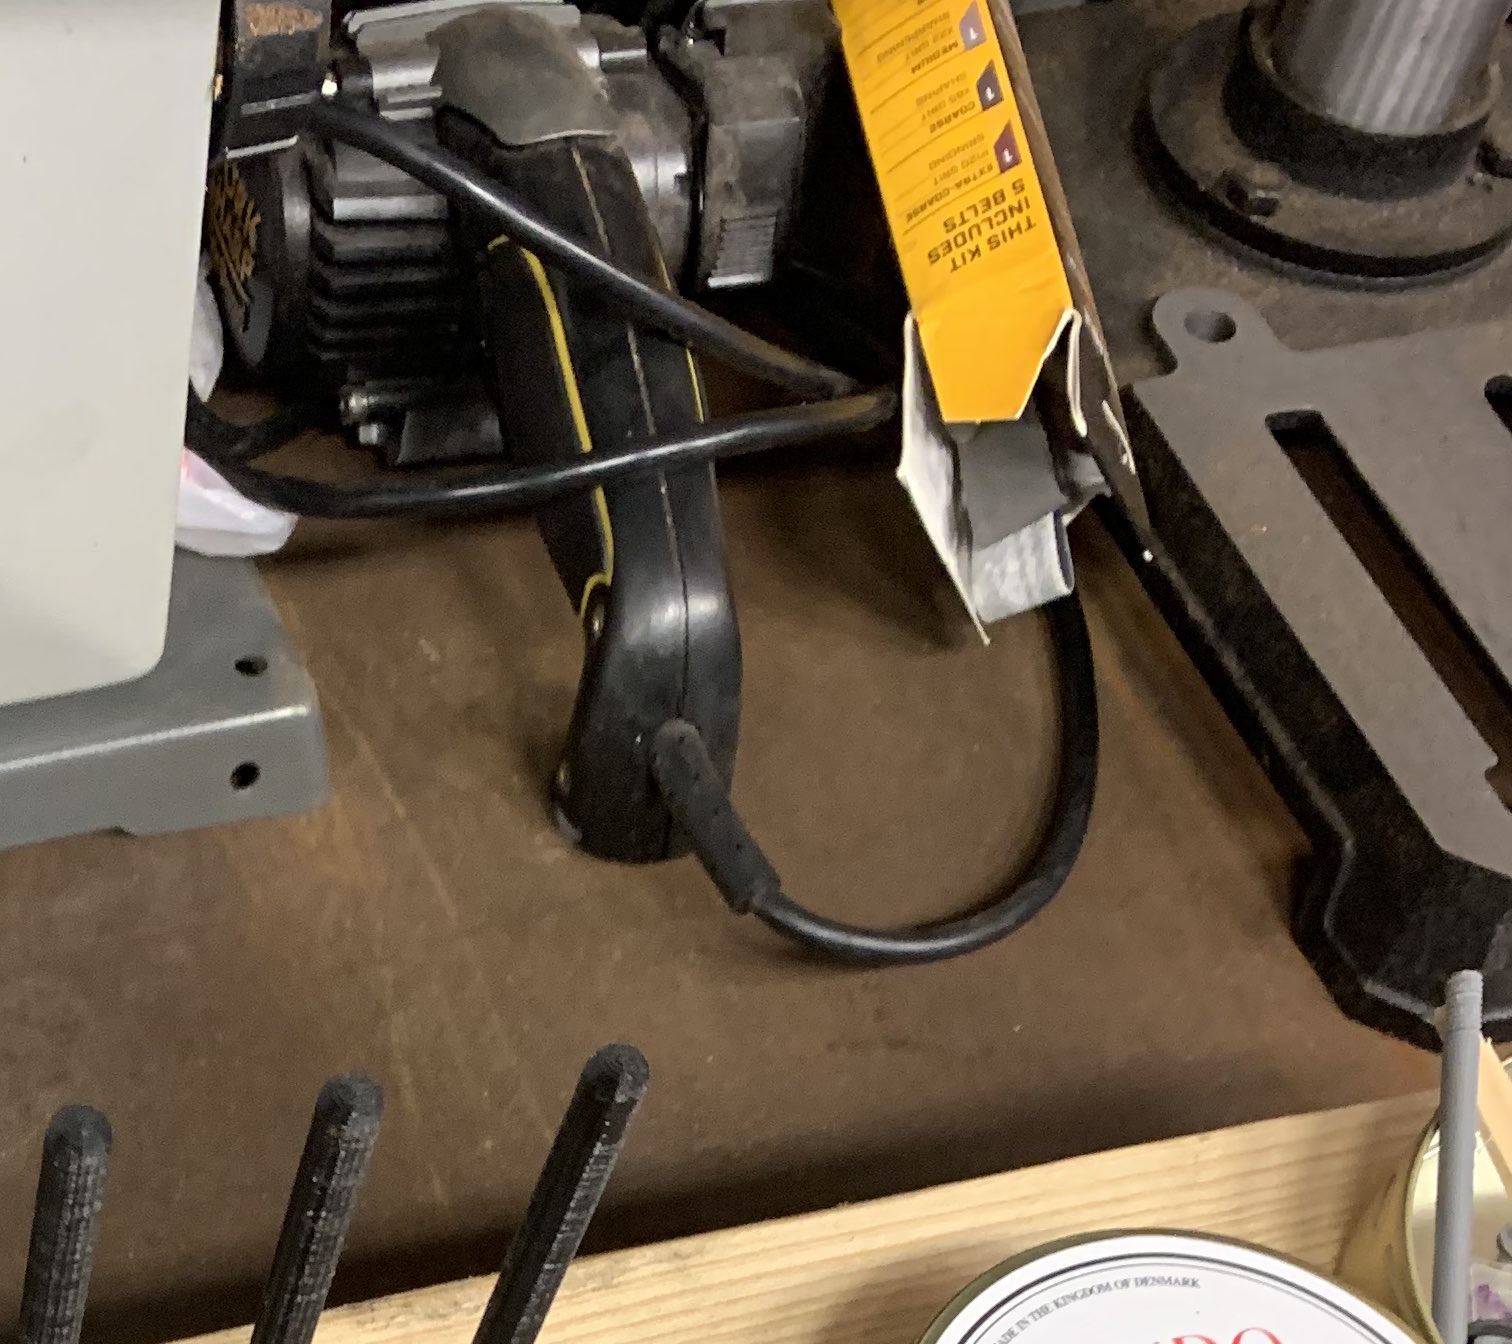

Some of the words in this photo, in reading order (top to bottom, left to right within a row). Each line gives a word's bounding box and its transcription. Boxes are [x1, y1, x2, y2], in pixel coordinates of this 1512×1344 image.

[969, 26, 978, 41] 1
[911, 40, 959, 74] MEDIUM
[985, 86, 995, 102] 1
[930, 101, 976, 134] COARSE
[1003, 147, 1013, 163] 1
[906, 163, 994, 223] EXTRA-COARSE
[943, 188, 1007, 234] BELTS
[927, 195, 1031, 265] INCLUDES
[986, 215, 1037, 251] THIS
[950, 244, 982, 273] KIT
[1017, 1317, 1030, 1333] IN
[1029, 1303, 1053, 1322] THE
[1053, 1281, 1113, 1309] KINGDOM
[1114, 1278, 1131, 1290] OF
[1134, 1275, 1201, 1289] DENMARK
